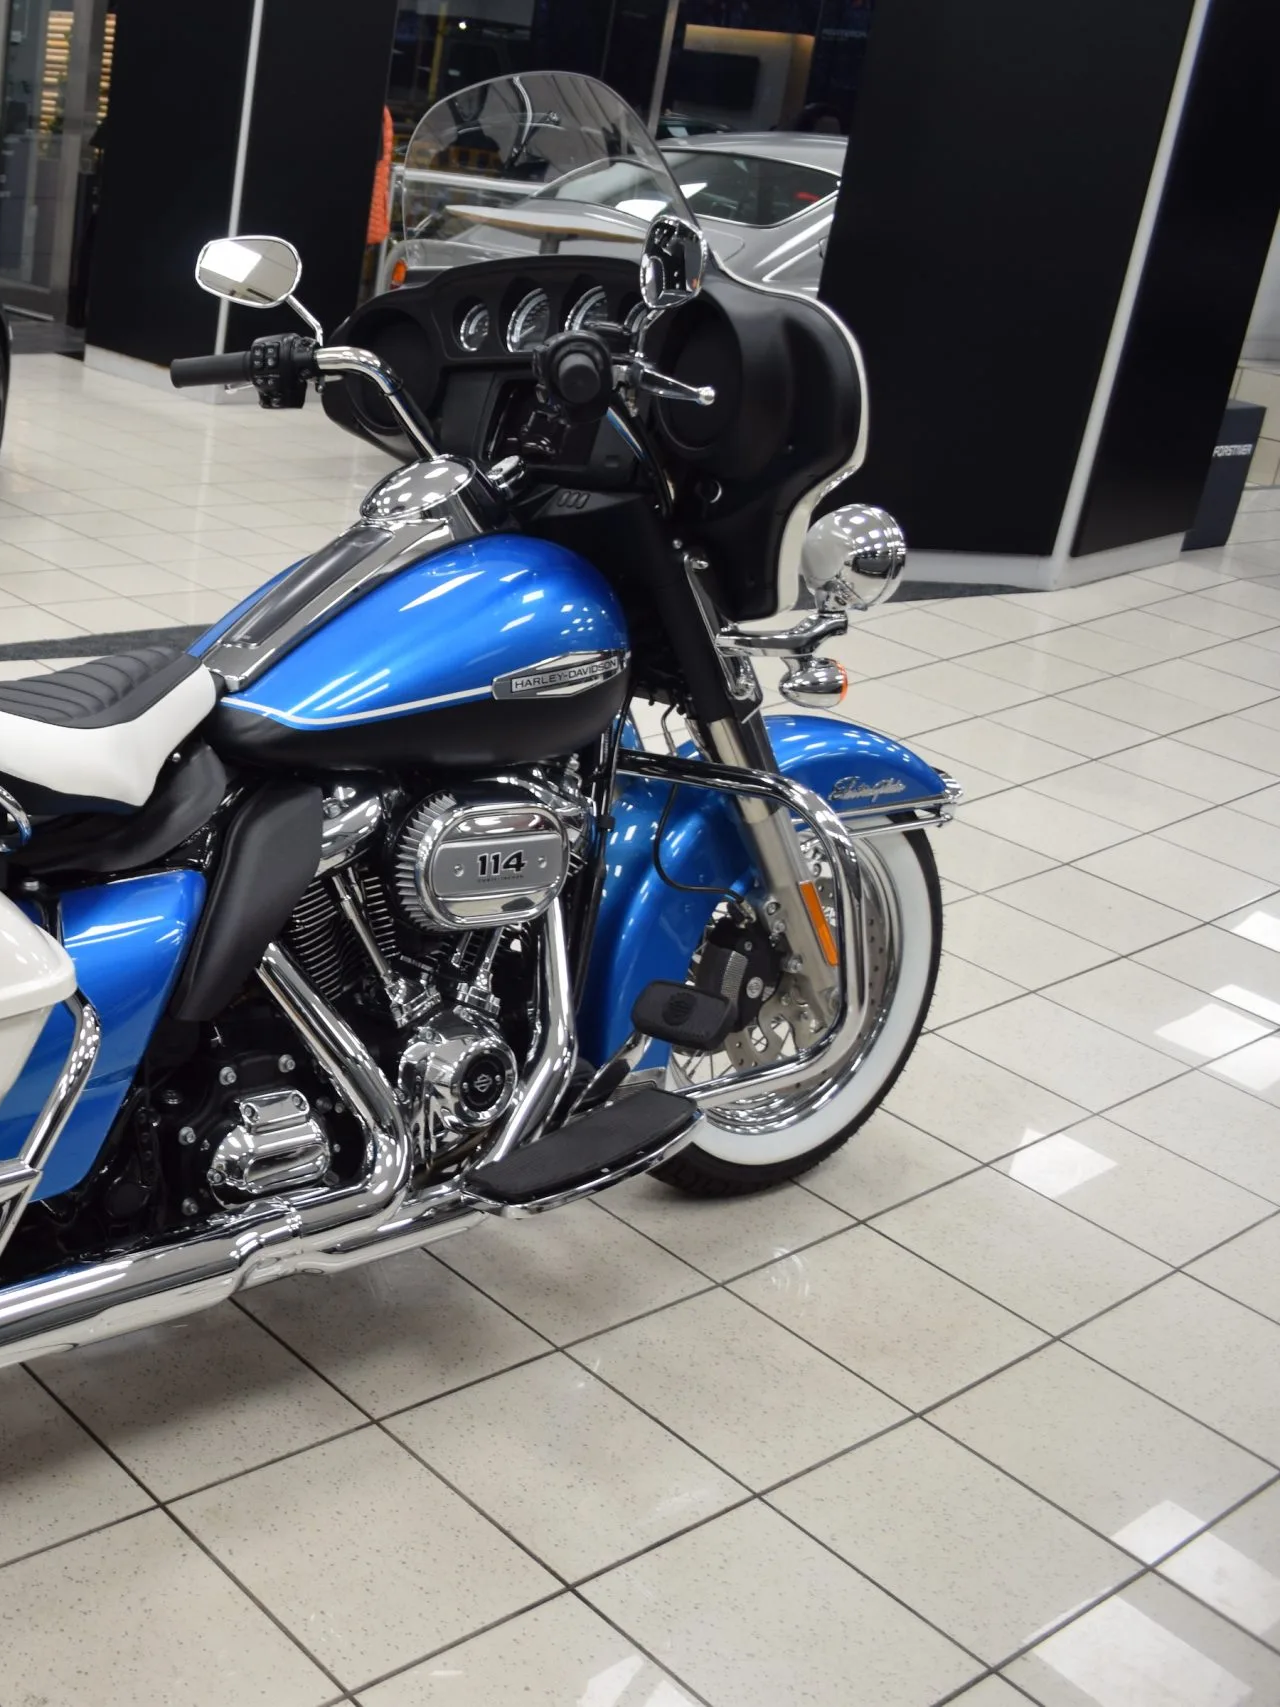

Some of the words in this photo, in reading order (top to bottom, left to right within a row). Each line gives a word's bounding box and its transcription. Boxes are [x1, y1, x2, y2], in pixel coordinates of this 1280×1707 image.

[1213, 444, 1253, 457] FORSTNER
[515, 658, 618, 689] HARLEY-DAVIDSON
[477, 849, 528, 877] 114
